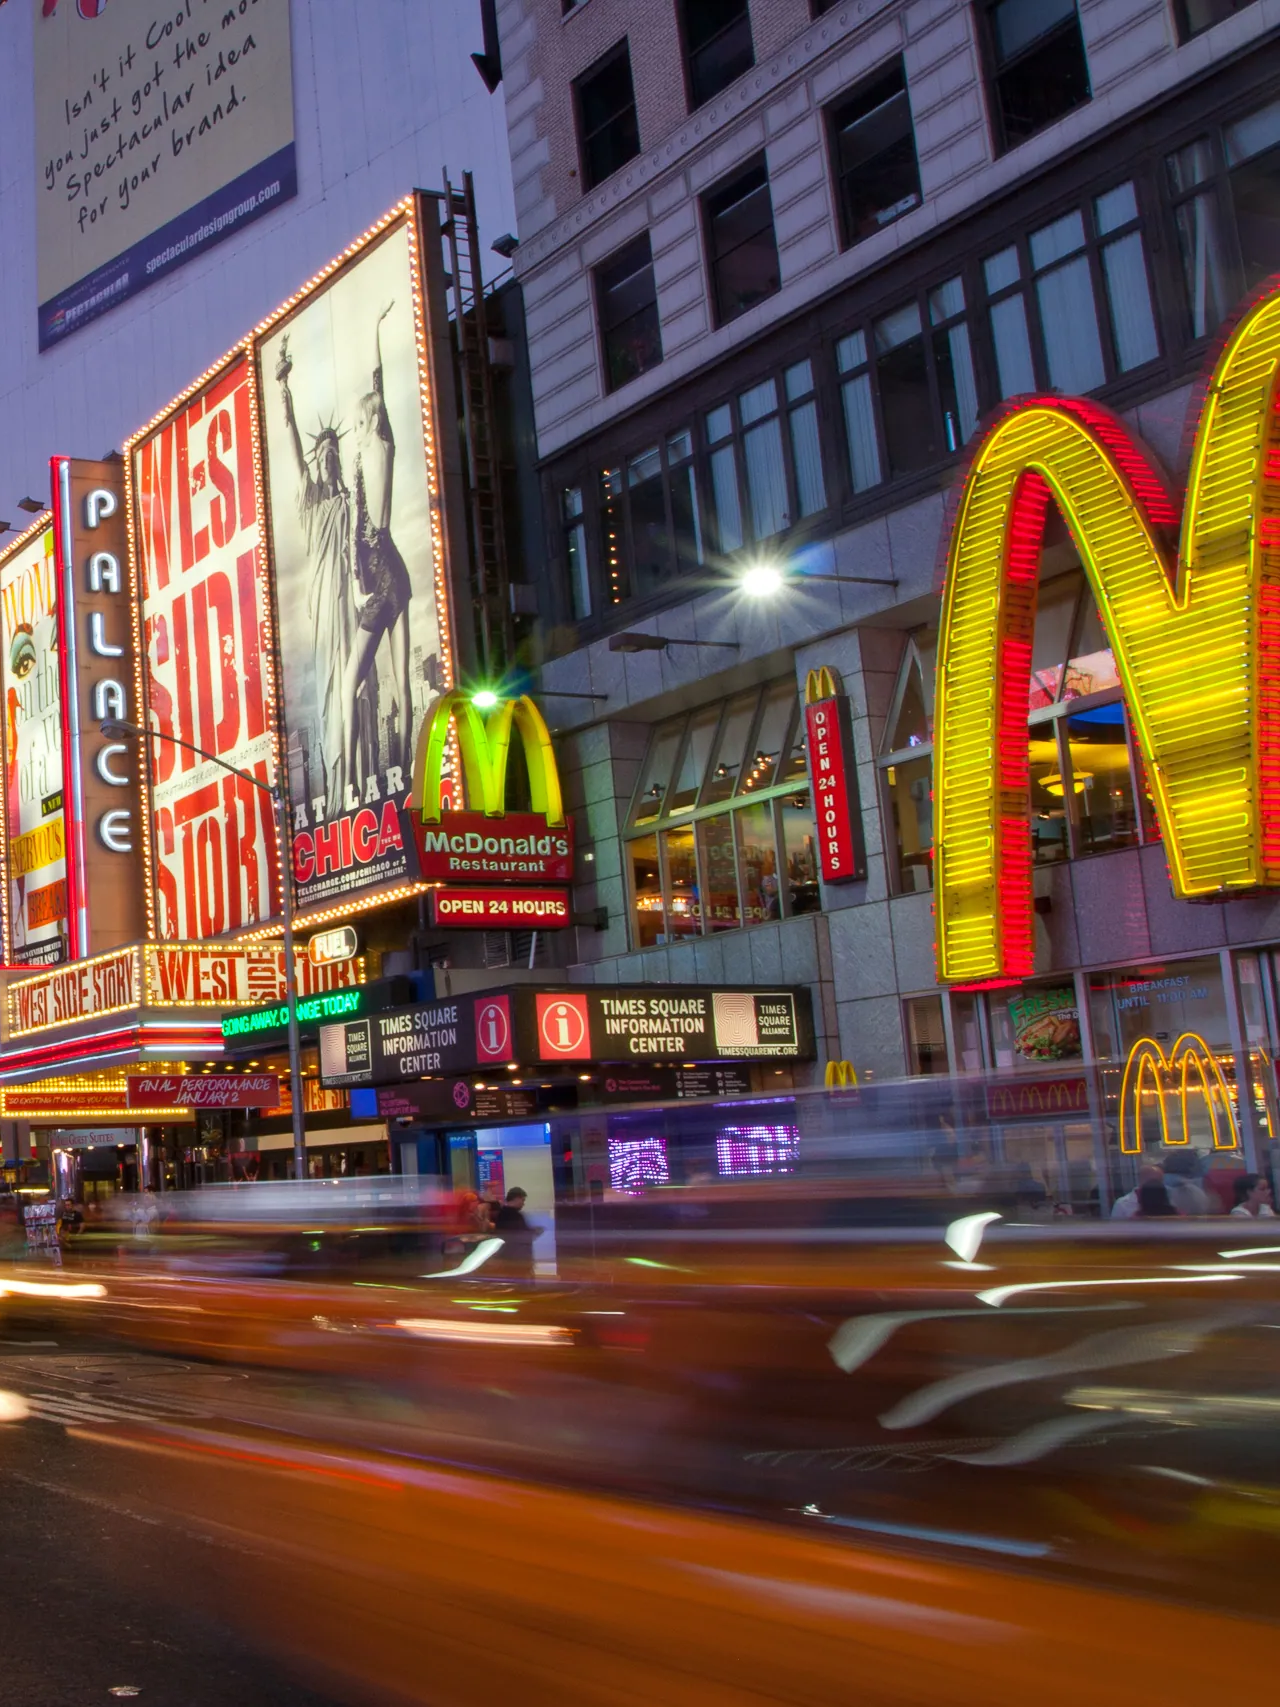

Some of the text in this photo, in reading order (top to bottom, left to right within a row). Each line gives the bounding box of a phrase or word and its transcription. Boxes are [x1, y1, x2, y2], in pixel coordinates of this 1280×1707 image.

[119, 44, 137, 77] it
[206, 34, 257, 86] idea
[45, 31, 211, 190] you just got the
[77, 197, 108, 234] for
[119, 154, 161, 210] your
[145, 179, 280, 275] spectaculardesigngroup.com
[87, 489, 132, 853] PALACE
[814, 711, 841, 871] OPEN 24 HOURS
[294, 795, 326, 831] AT
[12, 822, 62, 876] NERVOUS
[424, 831, 569, 857] McDonald's
[449, 856, 547, 872] Restaurant
[297, 860, 391, 898] TELECHARGE.COM/CHICAGO
[438, 899, 566, 916] OPEN 24 HOURS
[314, 932, 349, 963] FUEL
[158, 950, 241, 1002] WEST
[1129, 975, 1191, 994] BREAKFAST
[19, 980, 49, 1031] WEST
[54, 967, 89, 1021] SIDE
[93, 954, 134, 1012] STORY
[1118, 994, 1150, 1010] UNTIL
[1189, 987, 1208, 1000] AM
[222, 1017, 250, 1037] GOING
[322, 991, 360, 1016] TODAY
[601, 999, 706, 1016] TIMES SQUARE
[760, 1004, 787, 1015] TIMES
[1057, 1013, 1072, 1022] The
[380, 1005, 458, 1036] TIMES SQUARE
[605, 1017, 705, 1035] INFORMATION
[758, 1015, 791, 1028] SQUARE
[761, 1026, 790, 1036] ALLIANCE
[347, 1041, 367, 1054] SQUARE
[348, 1031, 365, 1042] TIMES
[382, 1028, 457, 1056] INFORMATION
[629, 1036, 685, 1054] CENTER
[349, 1053, 367, 1063] ALLIANCE
[717, 1046, 799, 1057] TIMESSQUARENYC.ORG
[399, 1053, 441, 1074] CENTER
[138, 1078, 271, 1093] FINAL PERFORMANCE
[172, 1091, 240, 1106] JANUARY 2
[89, 1131, 116, 1144] SUITES
